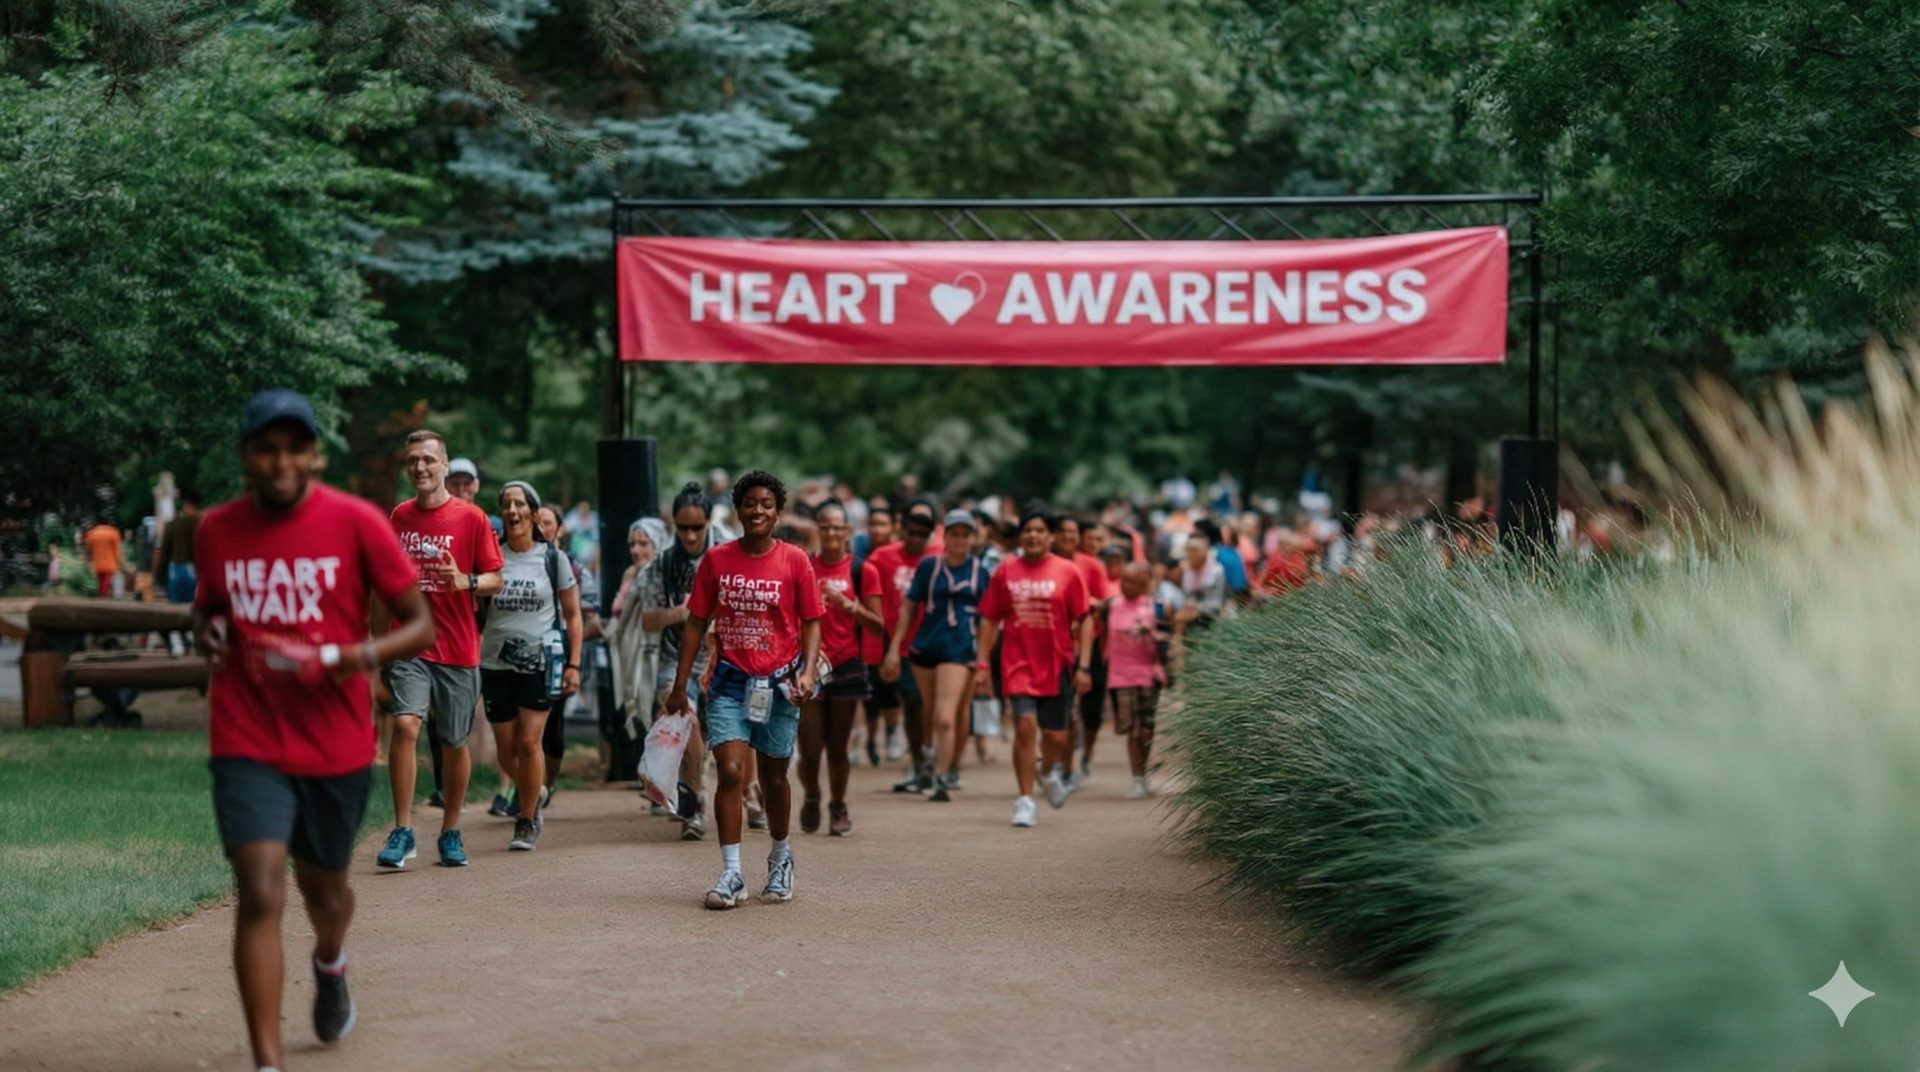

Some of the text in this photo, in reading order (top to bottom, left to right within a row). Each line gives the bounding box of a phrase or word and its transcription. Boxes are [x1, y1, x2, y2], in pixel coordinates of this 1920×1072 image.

[689, 268, 1428, 325] HEART AWARENESS
[224, 556, 341, 592] HEART
